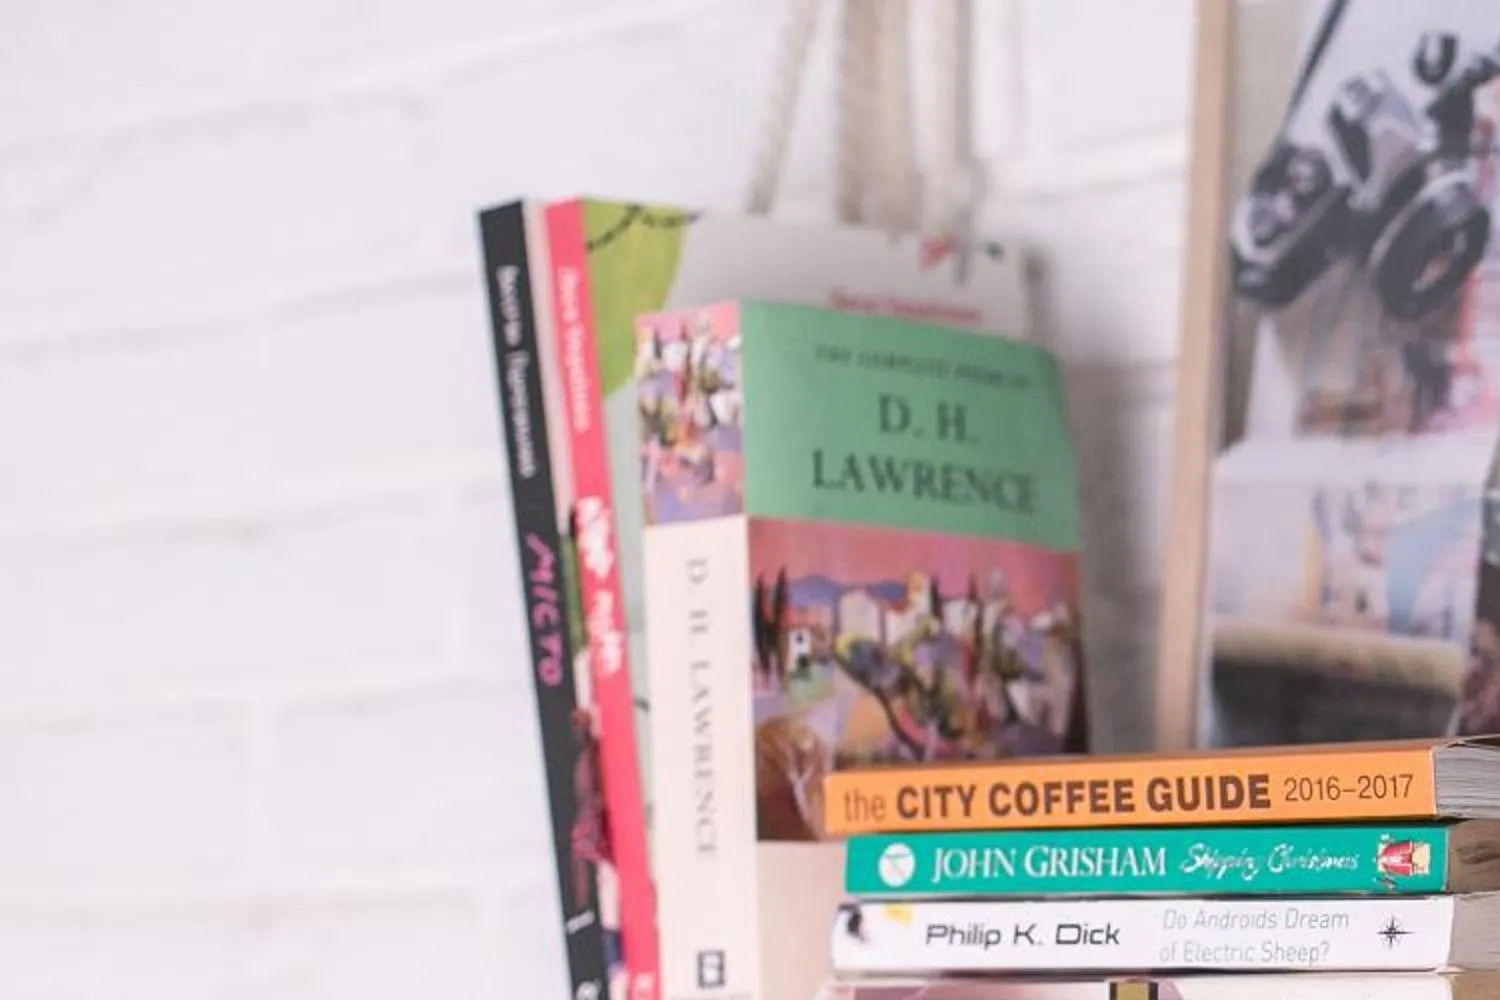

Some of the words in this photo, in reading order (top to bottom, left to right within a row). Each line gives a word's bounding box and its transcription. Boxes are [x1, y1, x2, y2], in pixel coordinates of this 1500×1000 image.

[877, 392, 926, 438] D.
[936, 401, 982, 443] H.
[811, 447, 1039, 516] LAWRENCE
[843, 789, 887, 822] the
[896, 783, 977, 820] CITY
[988, 778, 1136, 818] COFFEE
[1146, 773, 1272, 813] GUIDE
[931, 847, 1018, 883] JOHN
[1023, 844, 1167, 879] GRISHAM
[1179, 842, 1260, 881] Skipping
[1266, 842, 1361, 874] Christmas
[925, 923, 1002, 951] Philip
[1013, 923, 1044, 946] K.
[1055, 922, 1120, 946] Dick
[1162, 908, 1187, 931] Do
[1192, 908, 1278, 931] Androids
[1285, 907, 1350, 930] Dream
[1159, 941, 1178, 963] of
[1183, 940, 1254, 964] Electric
[1260, 940, 1331, 967] Sheep?
